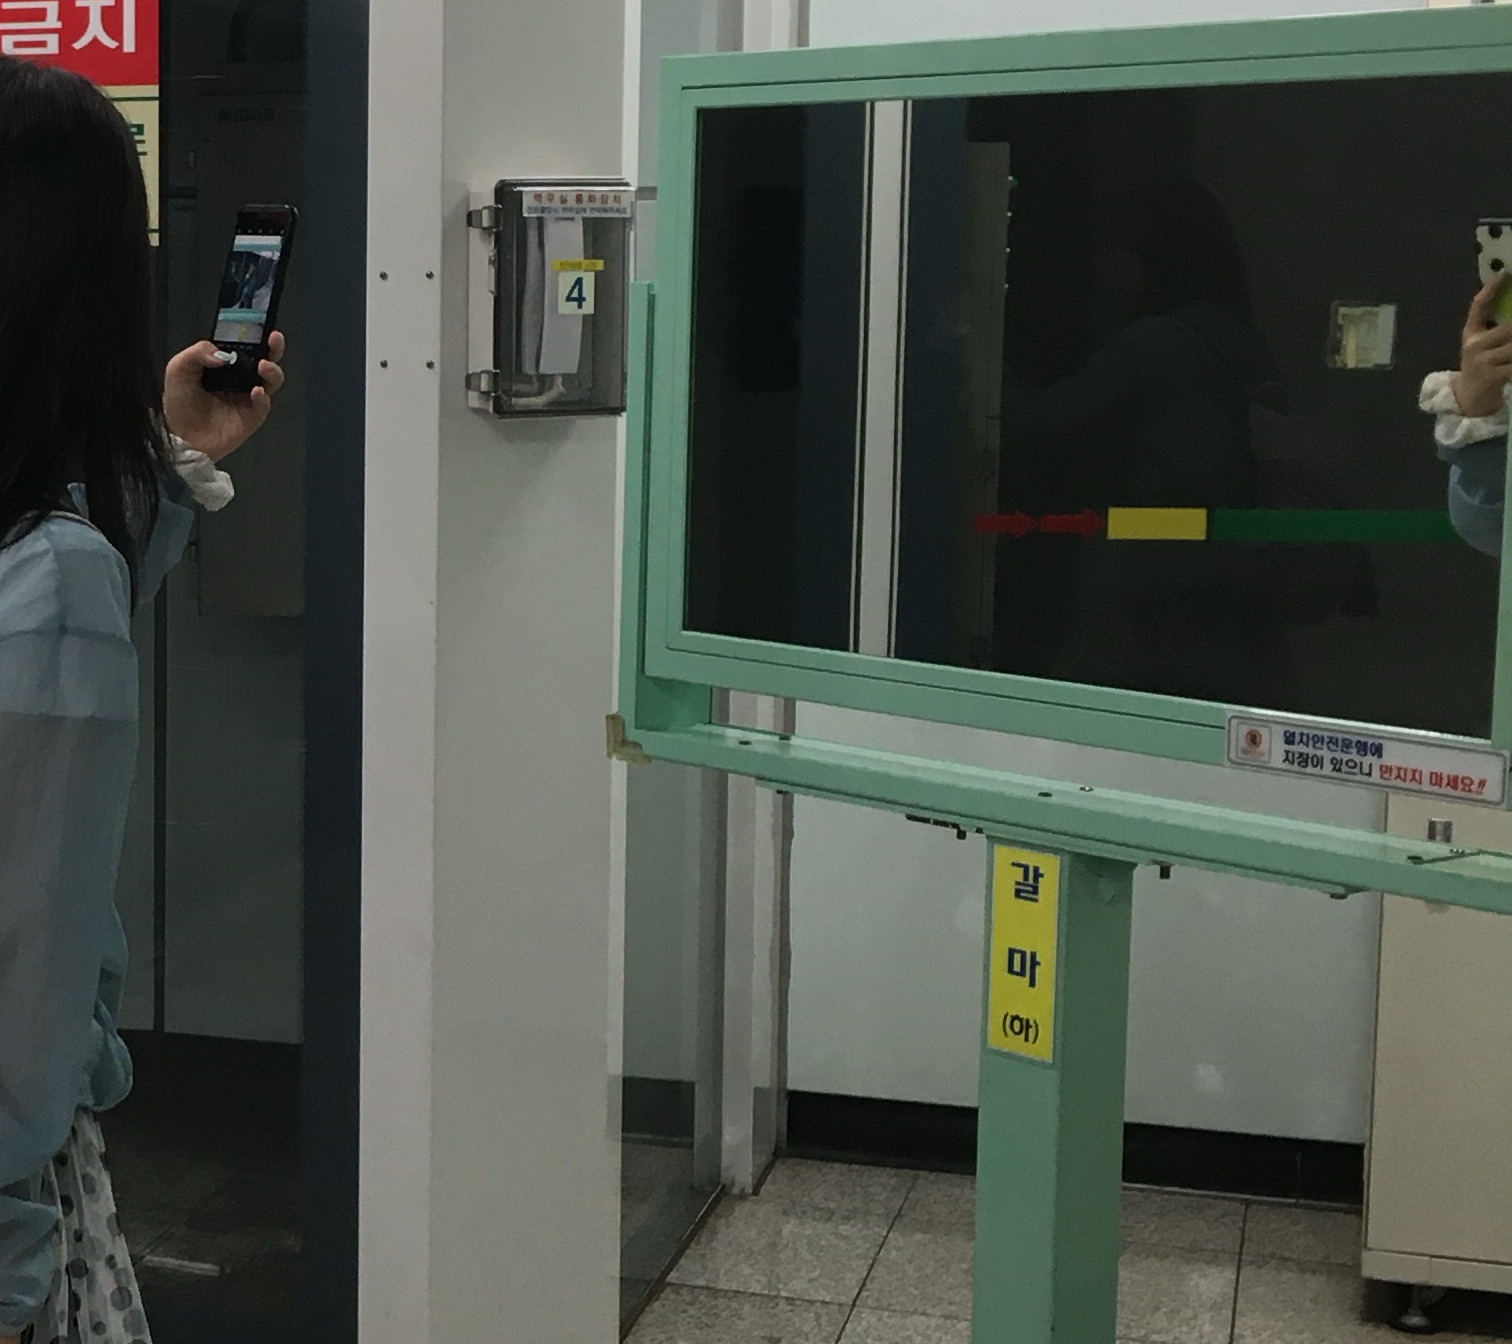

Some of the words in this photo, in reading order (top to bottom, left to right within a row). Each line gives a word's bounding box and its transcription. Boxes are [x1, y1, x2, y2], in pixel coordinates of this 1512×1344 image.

[565, 276, 587, 310] 4
[1283, 729, 1384, 759] 열차안전운행에
[1282, 749, 1324, 770] 지장이
[1330, 756, 1373, 777] 있으니
[1379, 763, 1423, 786] 만지지
